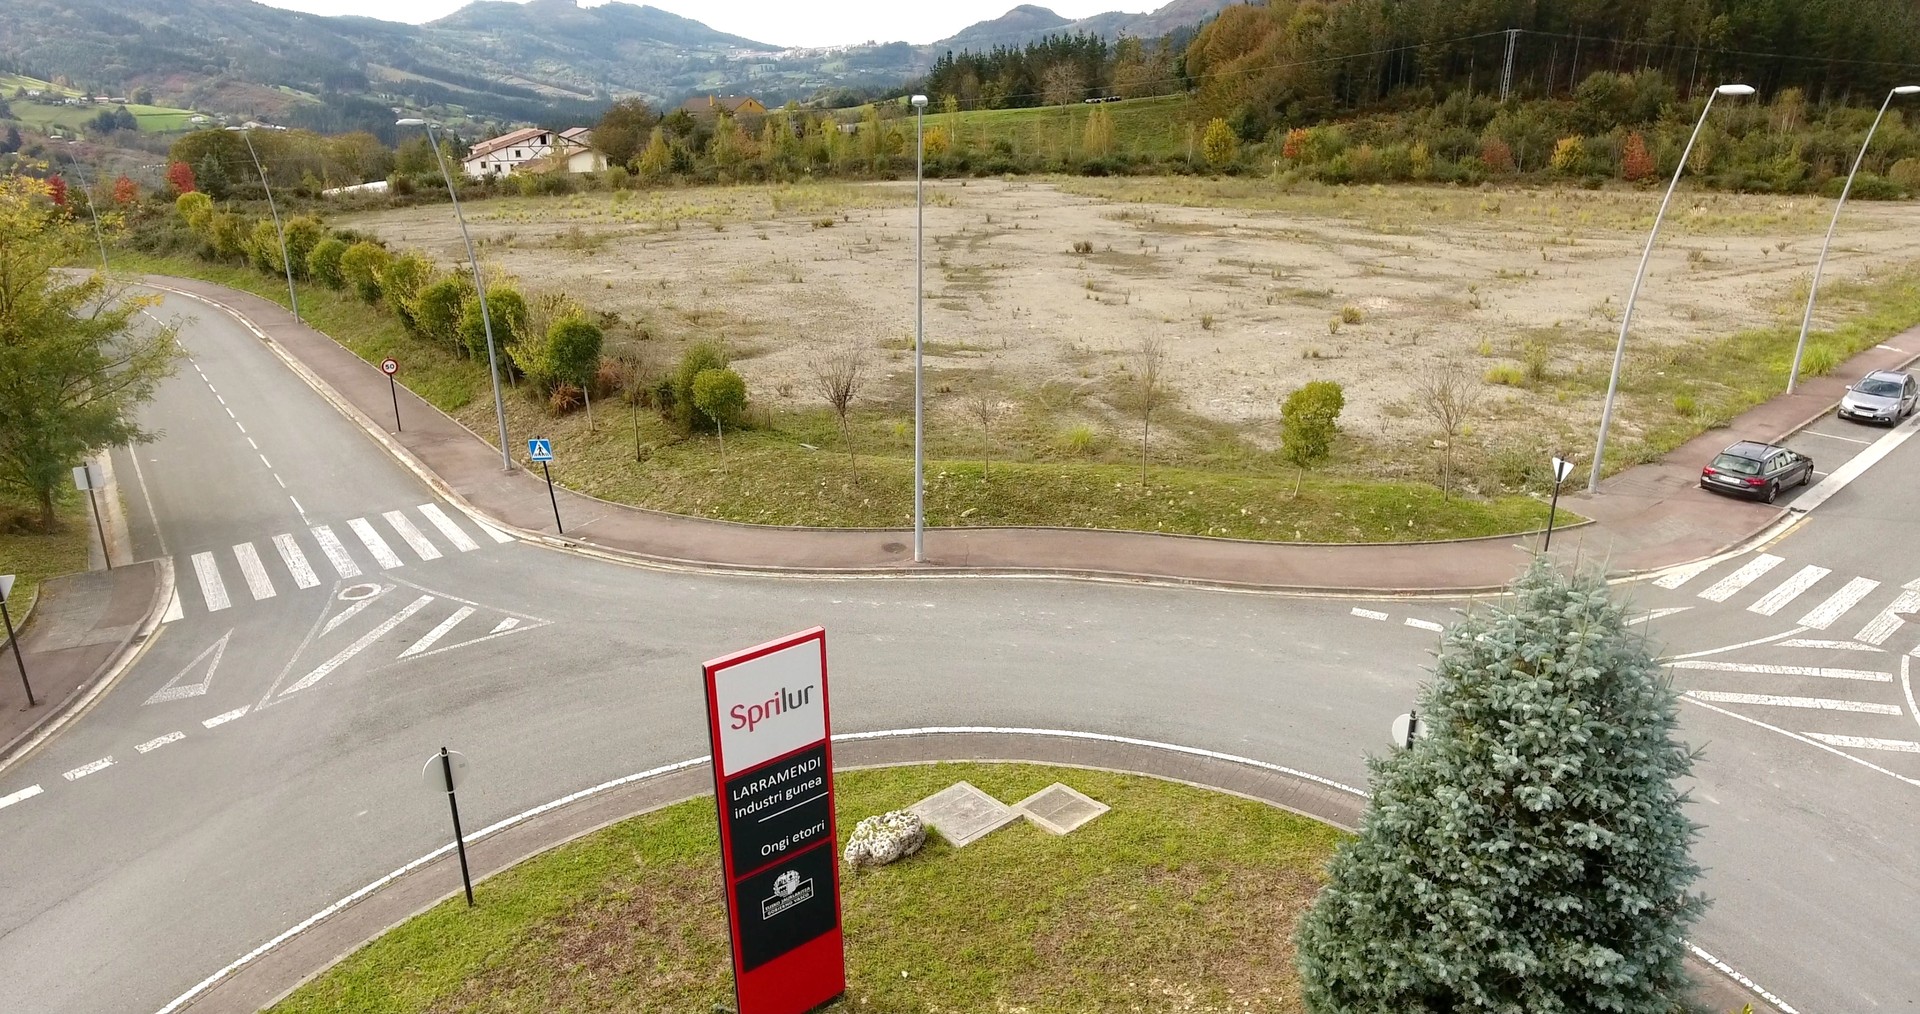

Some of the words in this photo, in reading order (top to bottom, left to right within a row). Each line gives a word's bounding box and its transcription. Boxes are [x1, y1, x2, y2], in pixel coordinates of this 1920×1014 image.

[730, 684, 814, 732] Sprilur
[733, 756, 821, 801] LARRAMENDI
[734, 790, 783, 819] industri
[785, 776, 822, 801] gunea
[761, 834, 789, 857] Ongi
[792, 820, 825, 843] etorri
